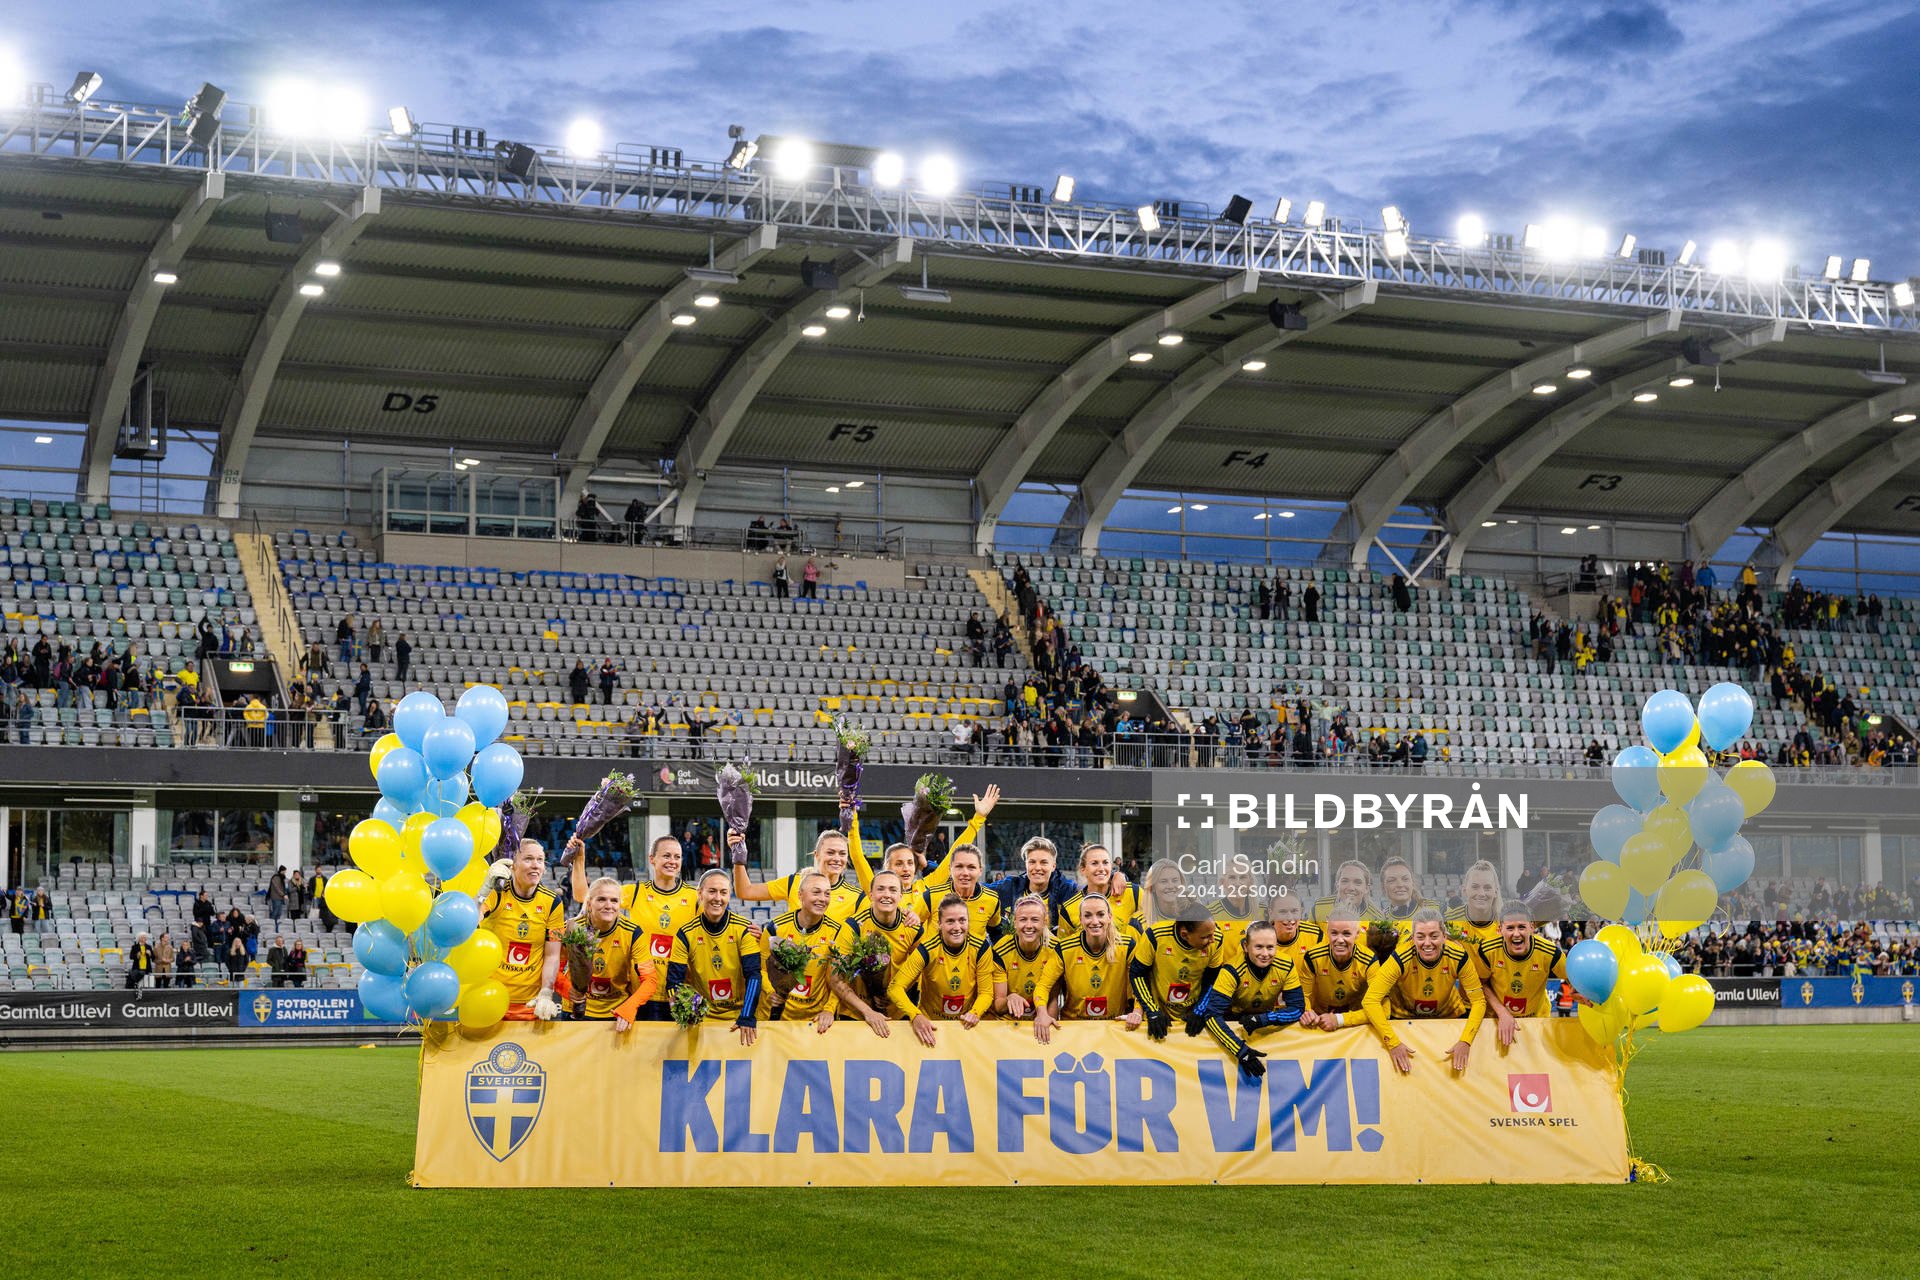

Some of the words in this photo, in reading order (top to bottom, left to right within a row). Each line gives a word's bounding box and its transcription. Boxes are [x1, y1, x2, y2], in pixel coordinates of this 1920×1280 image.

[382, 392, 439, 413] D5
[828, 423, 878, 443] F5
[1222, 450, 1269, 469] F4
[1578, 474, 1623, 491] F3
[677, 769, 691, 778] Got
[677, 777, 700, 785] Event
[1713, 988, 1745, 1001] amla
[1746, 988, 1779, 1001] Ullevi
[121, 1003, 180, 1018] Gamla
[184, 1002, 233, 1017] Ullevi
[276, 999, 347, 1009] FOTBOLLEN
[350, 998, 354, 1008] I
[0, 1004, 56, 1019] Gamla
[61, 1003, 111, 1018] Ullevi
[276, 1009, 349, 1020] SAMHÄLLET
[478, 1077, 533, 1085] SVERIGE
[659, 1060, 975, 1153] KLARA
[997, 1051, 1179, 1154] FÖR
[1197, 1058, 1384, 1152] VM!
[1490, 1118, 1546, 1127] SVENSKA
[1549, 1118, 1578, 1127] SPEL
